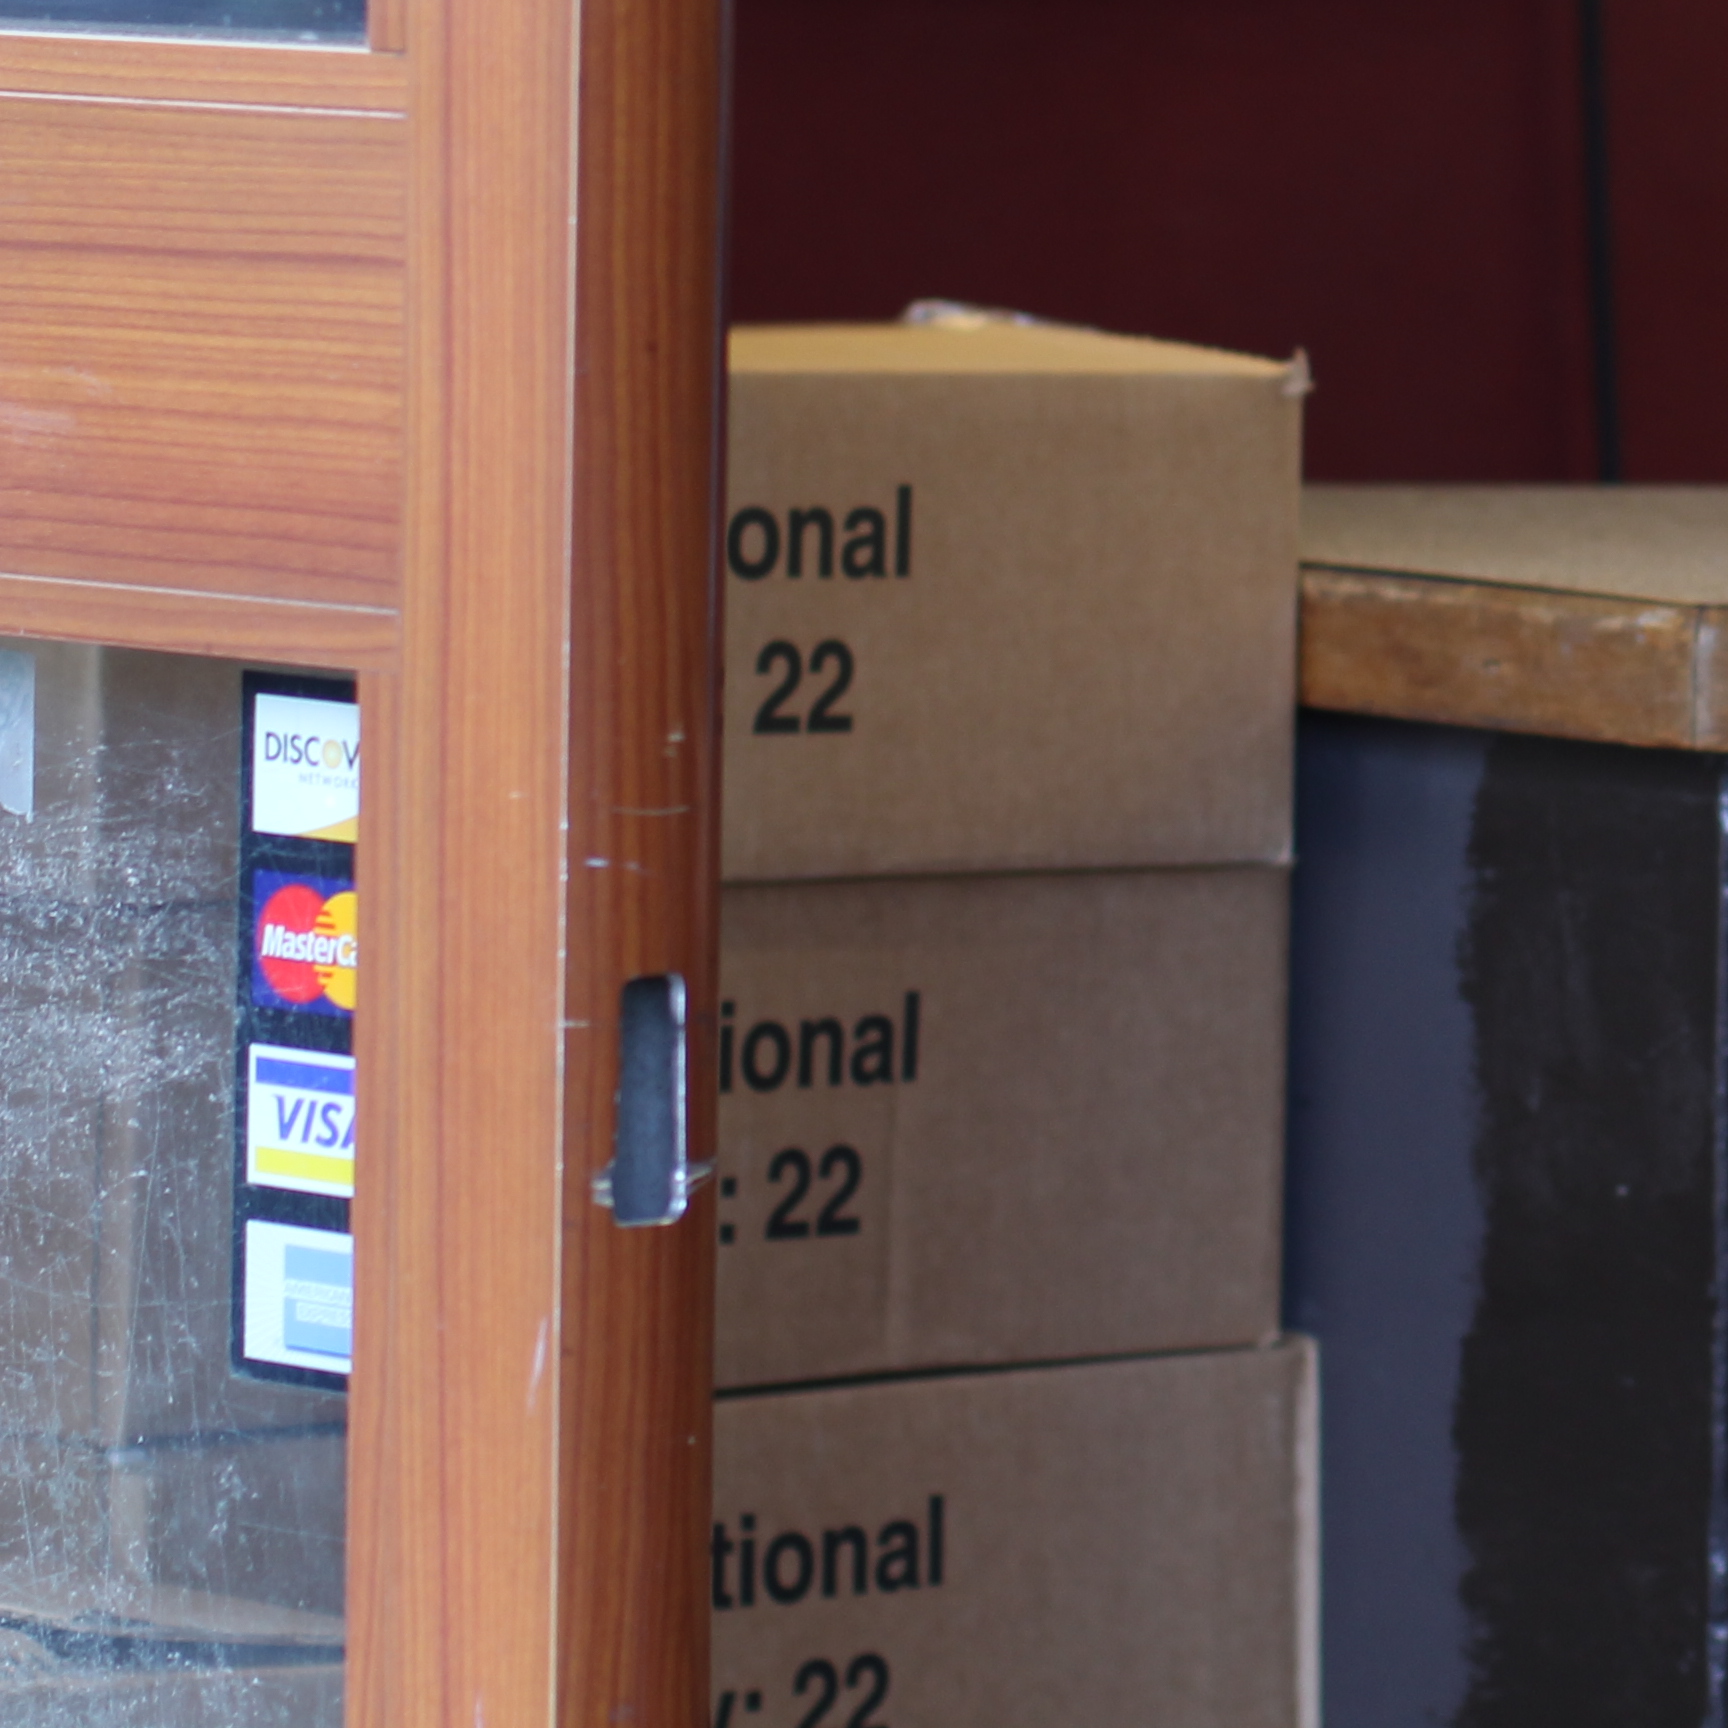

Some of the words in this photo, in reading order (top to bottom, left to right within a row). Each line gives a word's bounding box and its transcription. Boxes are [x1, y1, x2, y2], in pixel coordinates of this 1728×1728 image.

[726, 484, 913, 582] onal
[752, 638, 856, 735] 22
[718, 990, 921, 1094] ional
[763, 1143, 863, 1242] 22
